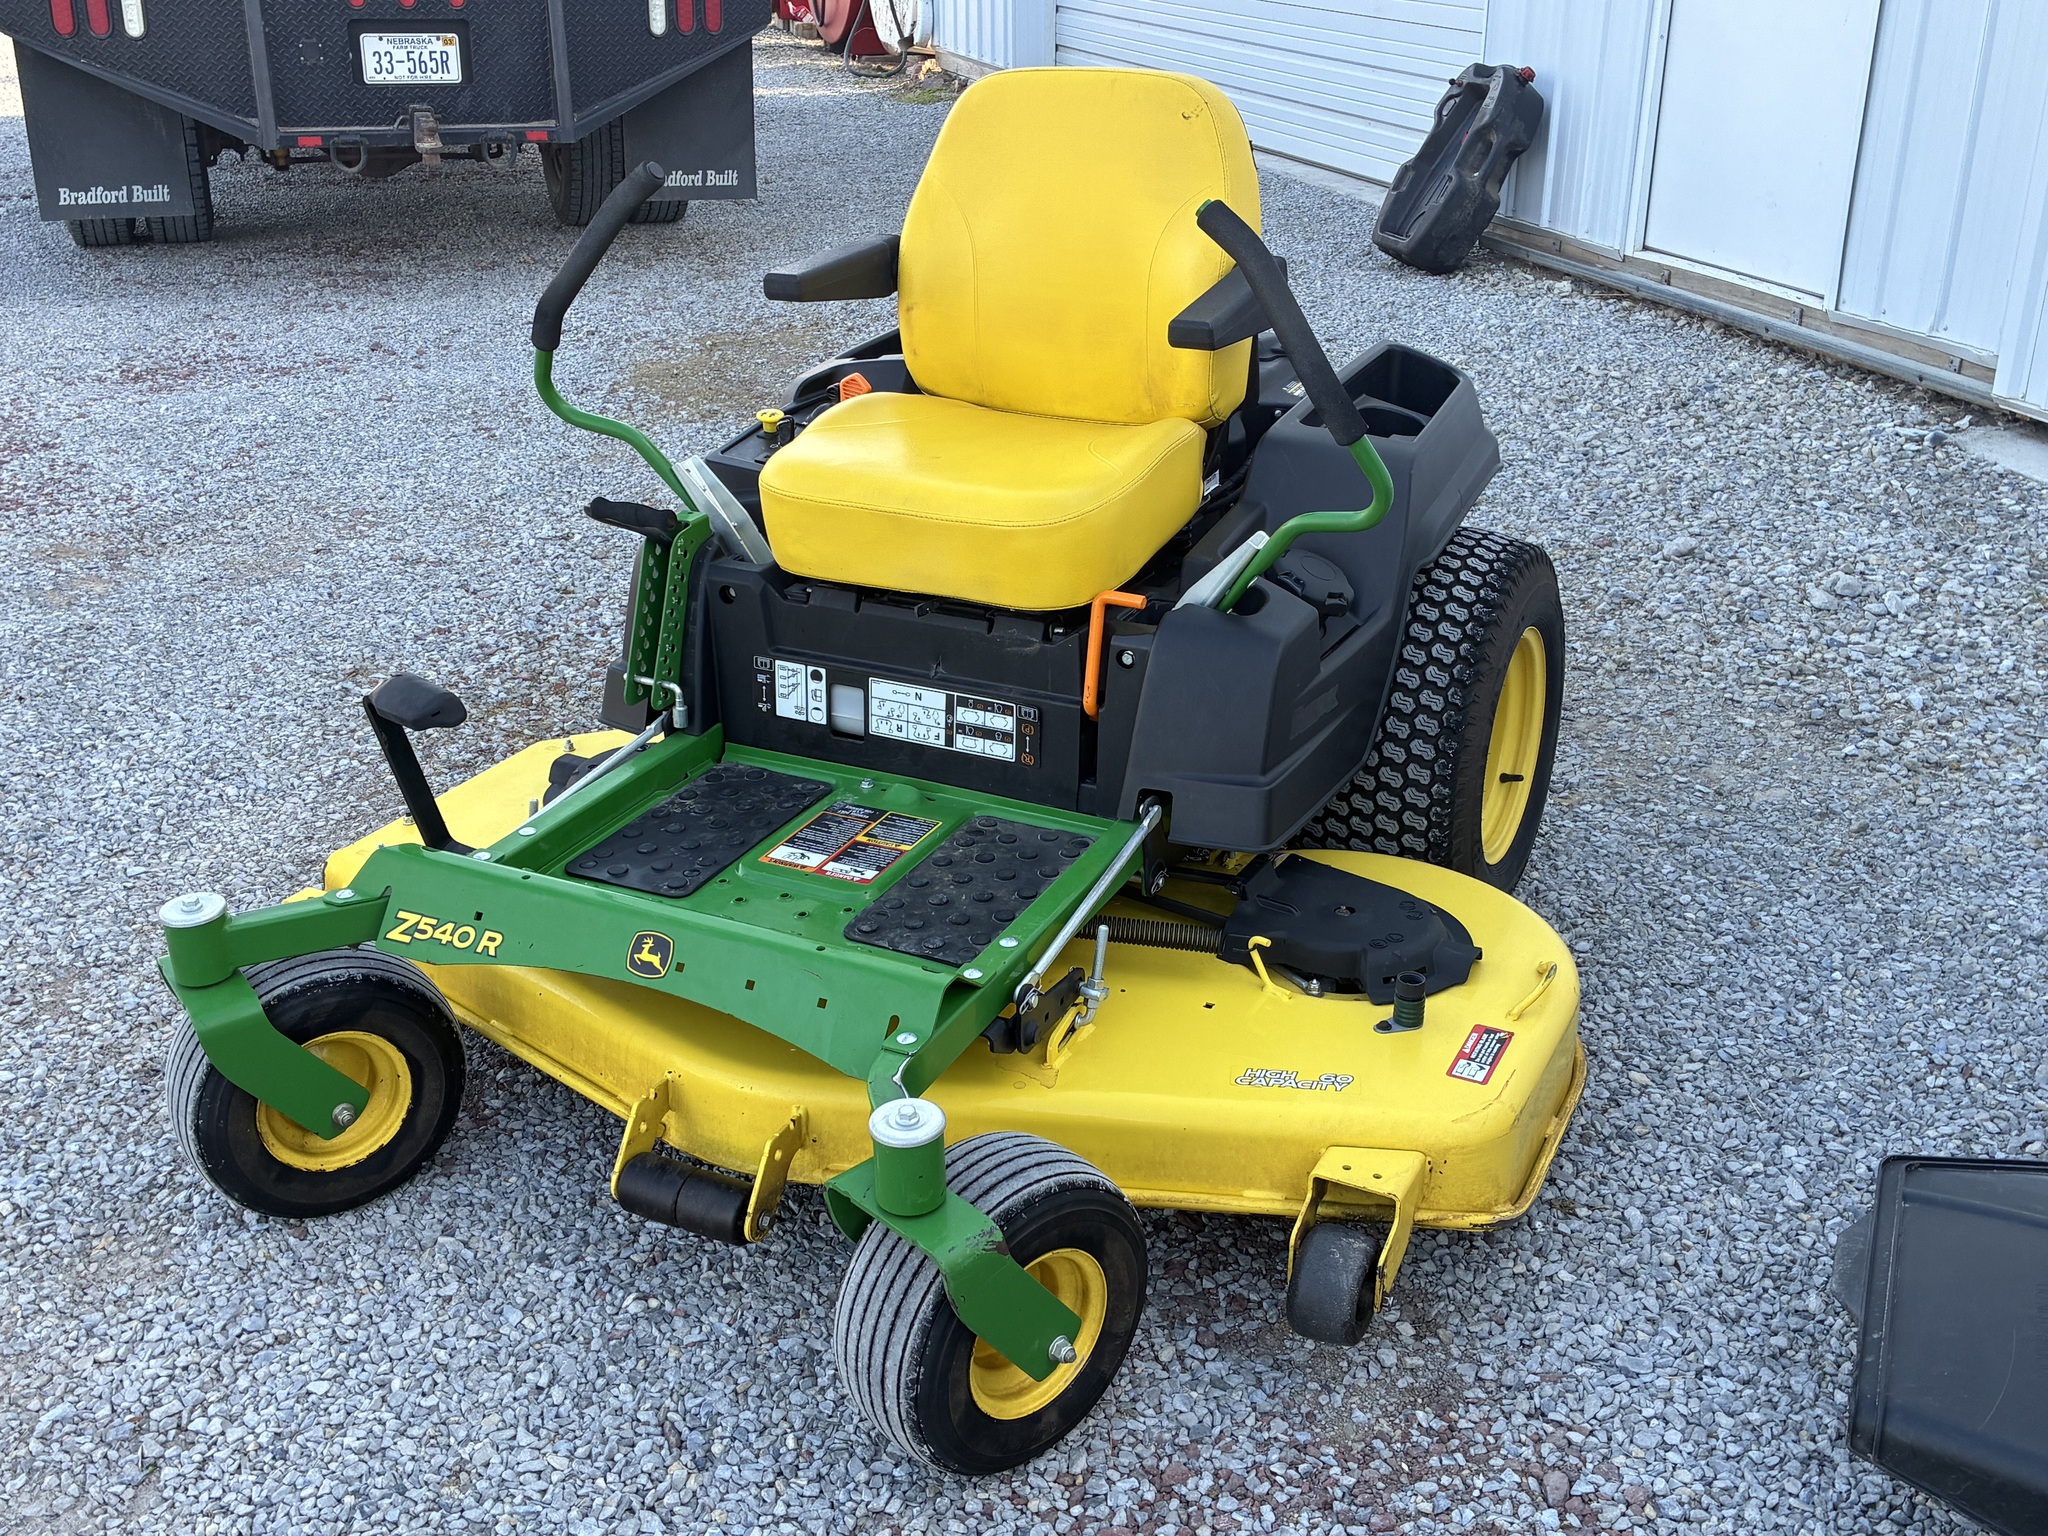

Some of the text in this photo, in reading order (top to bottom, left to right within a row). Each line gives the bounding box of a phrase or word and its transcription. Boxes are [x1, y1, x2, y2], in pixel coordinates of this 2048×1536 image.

[386, 37, 434, 45] NEBRASKA
[372, 50, 451, 75] 33-565R
[705, 169, 739, 186] Built
[58, 184, 171, 206] Bradford Built
[1244, 1068, 1355, 1083] HIGH 60
[1235, 1076, 1351, 1092] CAPACITY
